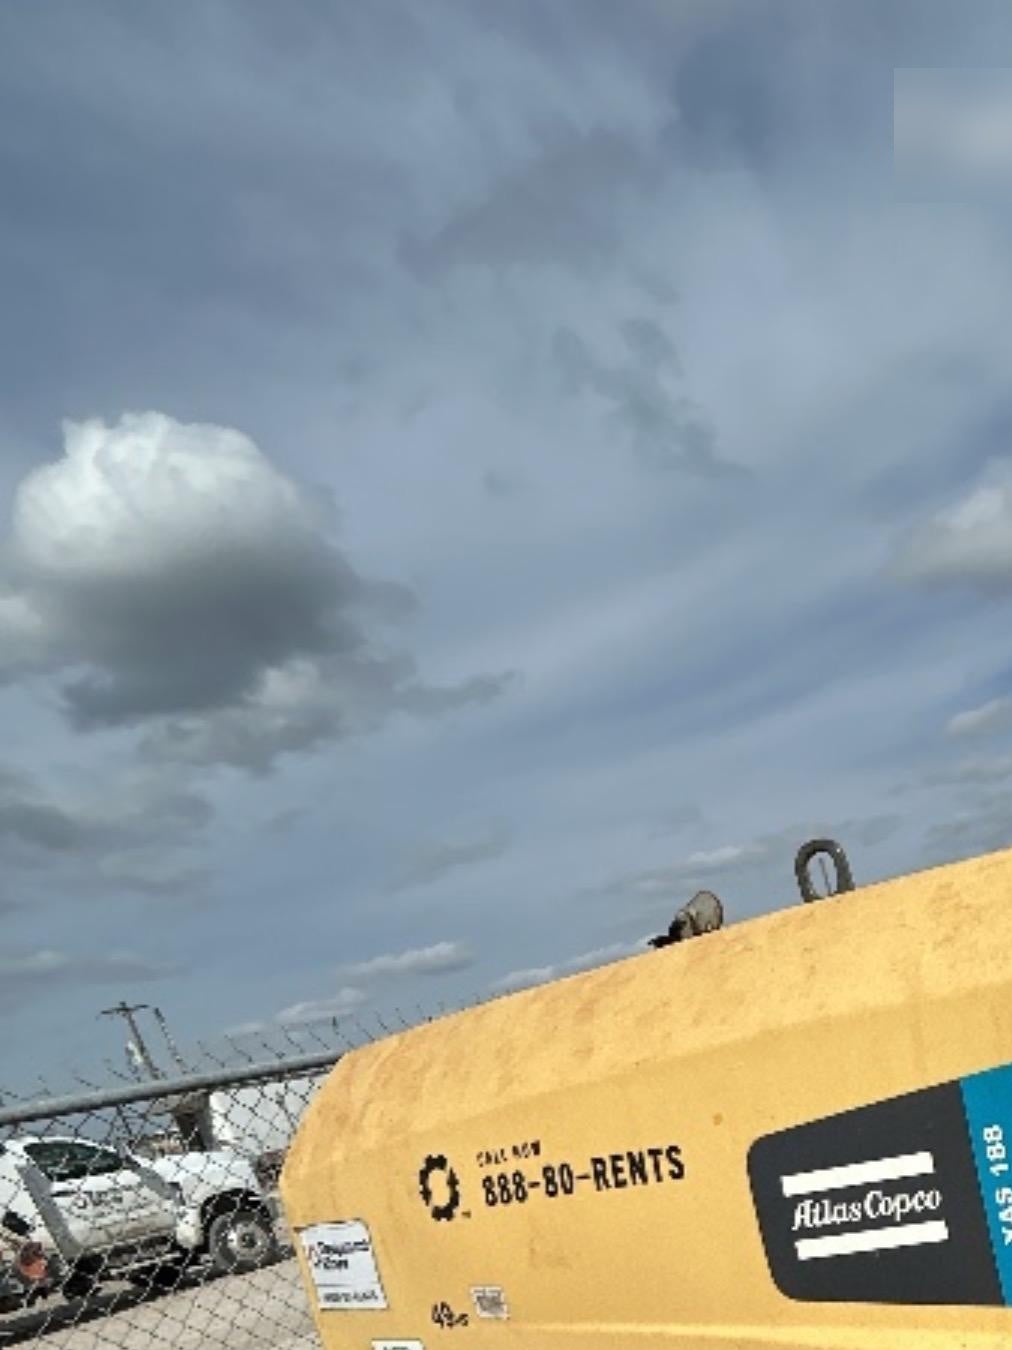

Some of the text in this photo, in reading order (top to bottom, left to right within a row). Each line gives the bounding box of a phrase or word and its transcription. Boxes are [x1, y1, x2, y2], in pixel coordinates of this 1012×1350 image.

[482, 1145, 685, 1207] 888-80-RENTS
[983, 1124, 1009, 1176] 188
[791, 1190, 942, 1231] Atlas Copco
